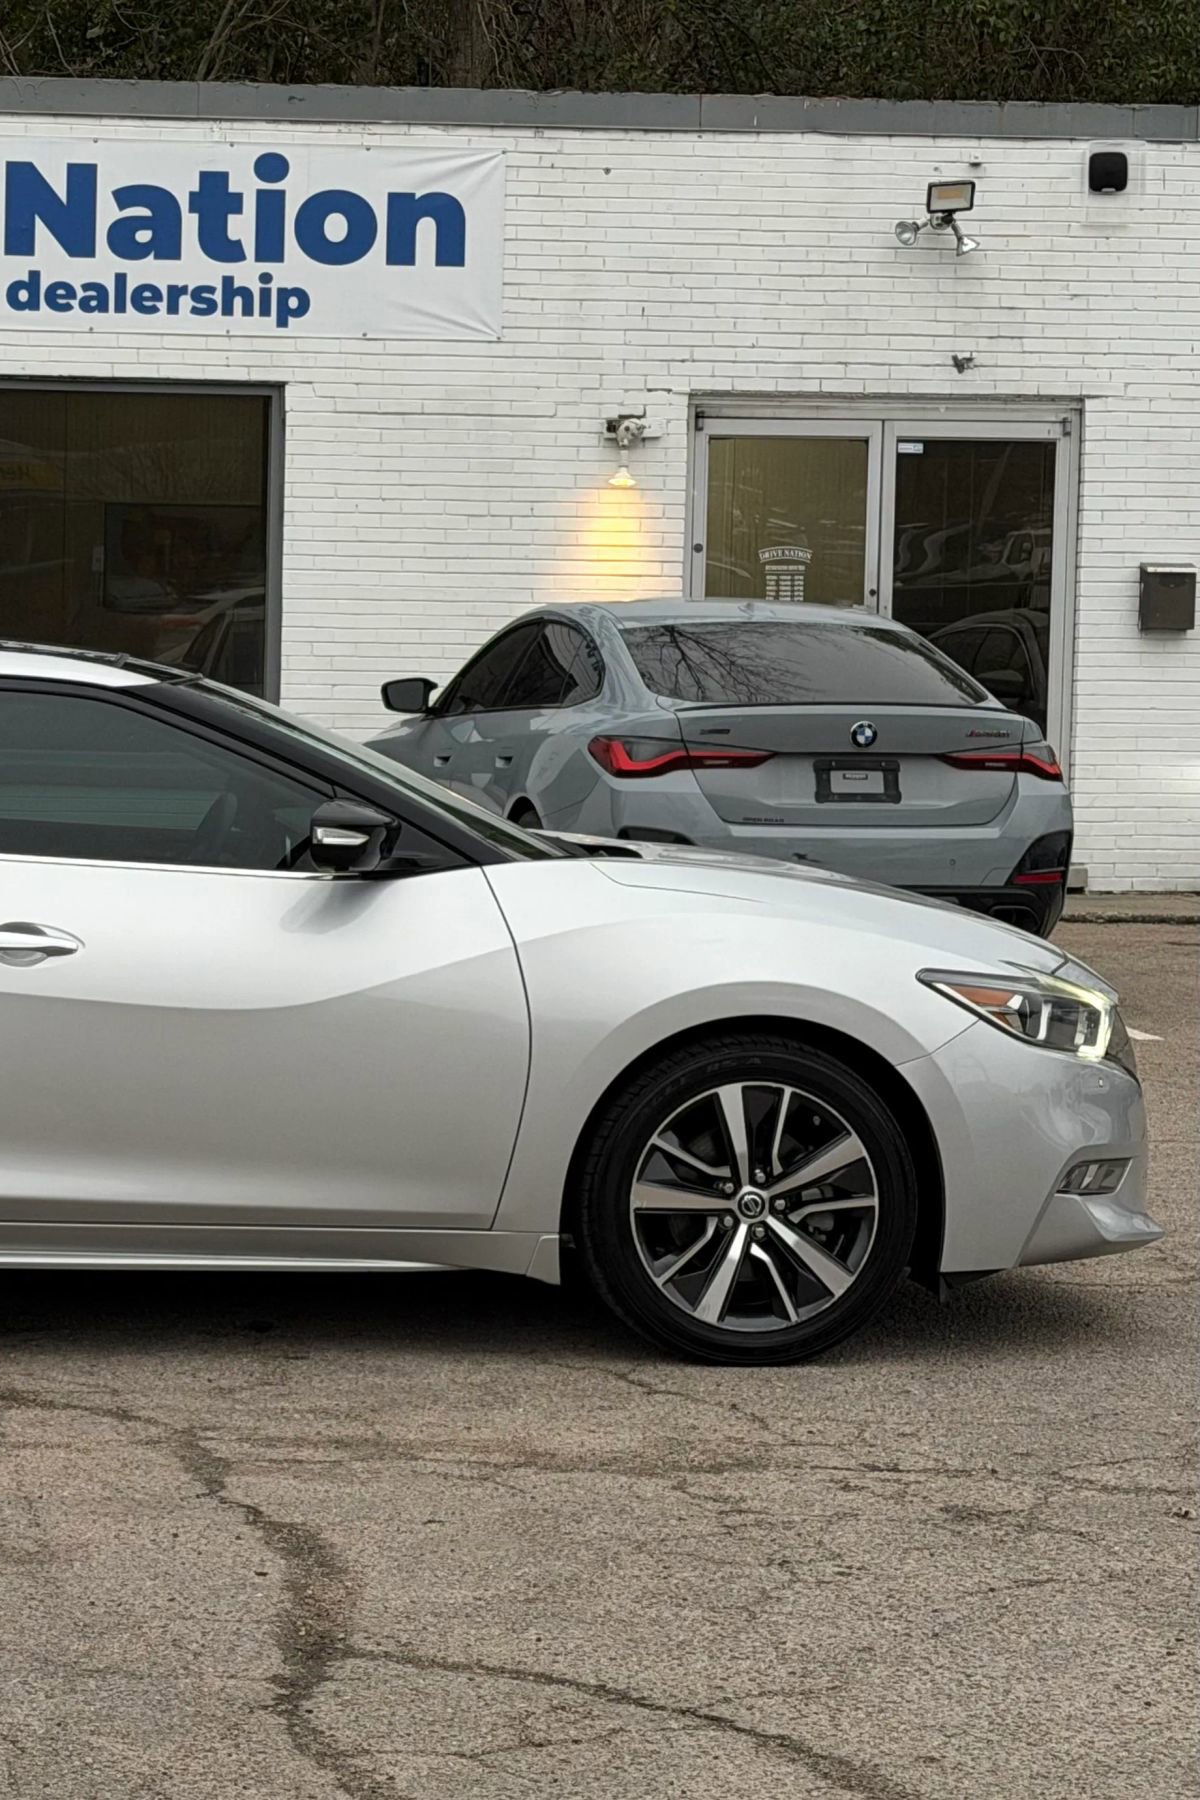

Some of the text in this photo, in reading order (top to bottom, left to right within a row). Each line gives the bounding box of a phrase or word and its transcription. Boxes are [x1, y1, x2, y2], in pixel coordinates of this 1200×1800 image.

[4, 152, 466, 267] Nation
[6, 272, 310, 328] dealership
[760, 549, 812, 560] DRIVE NATION
